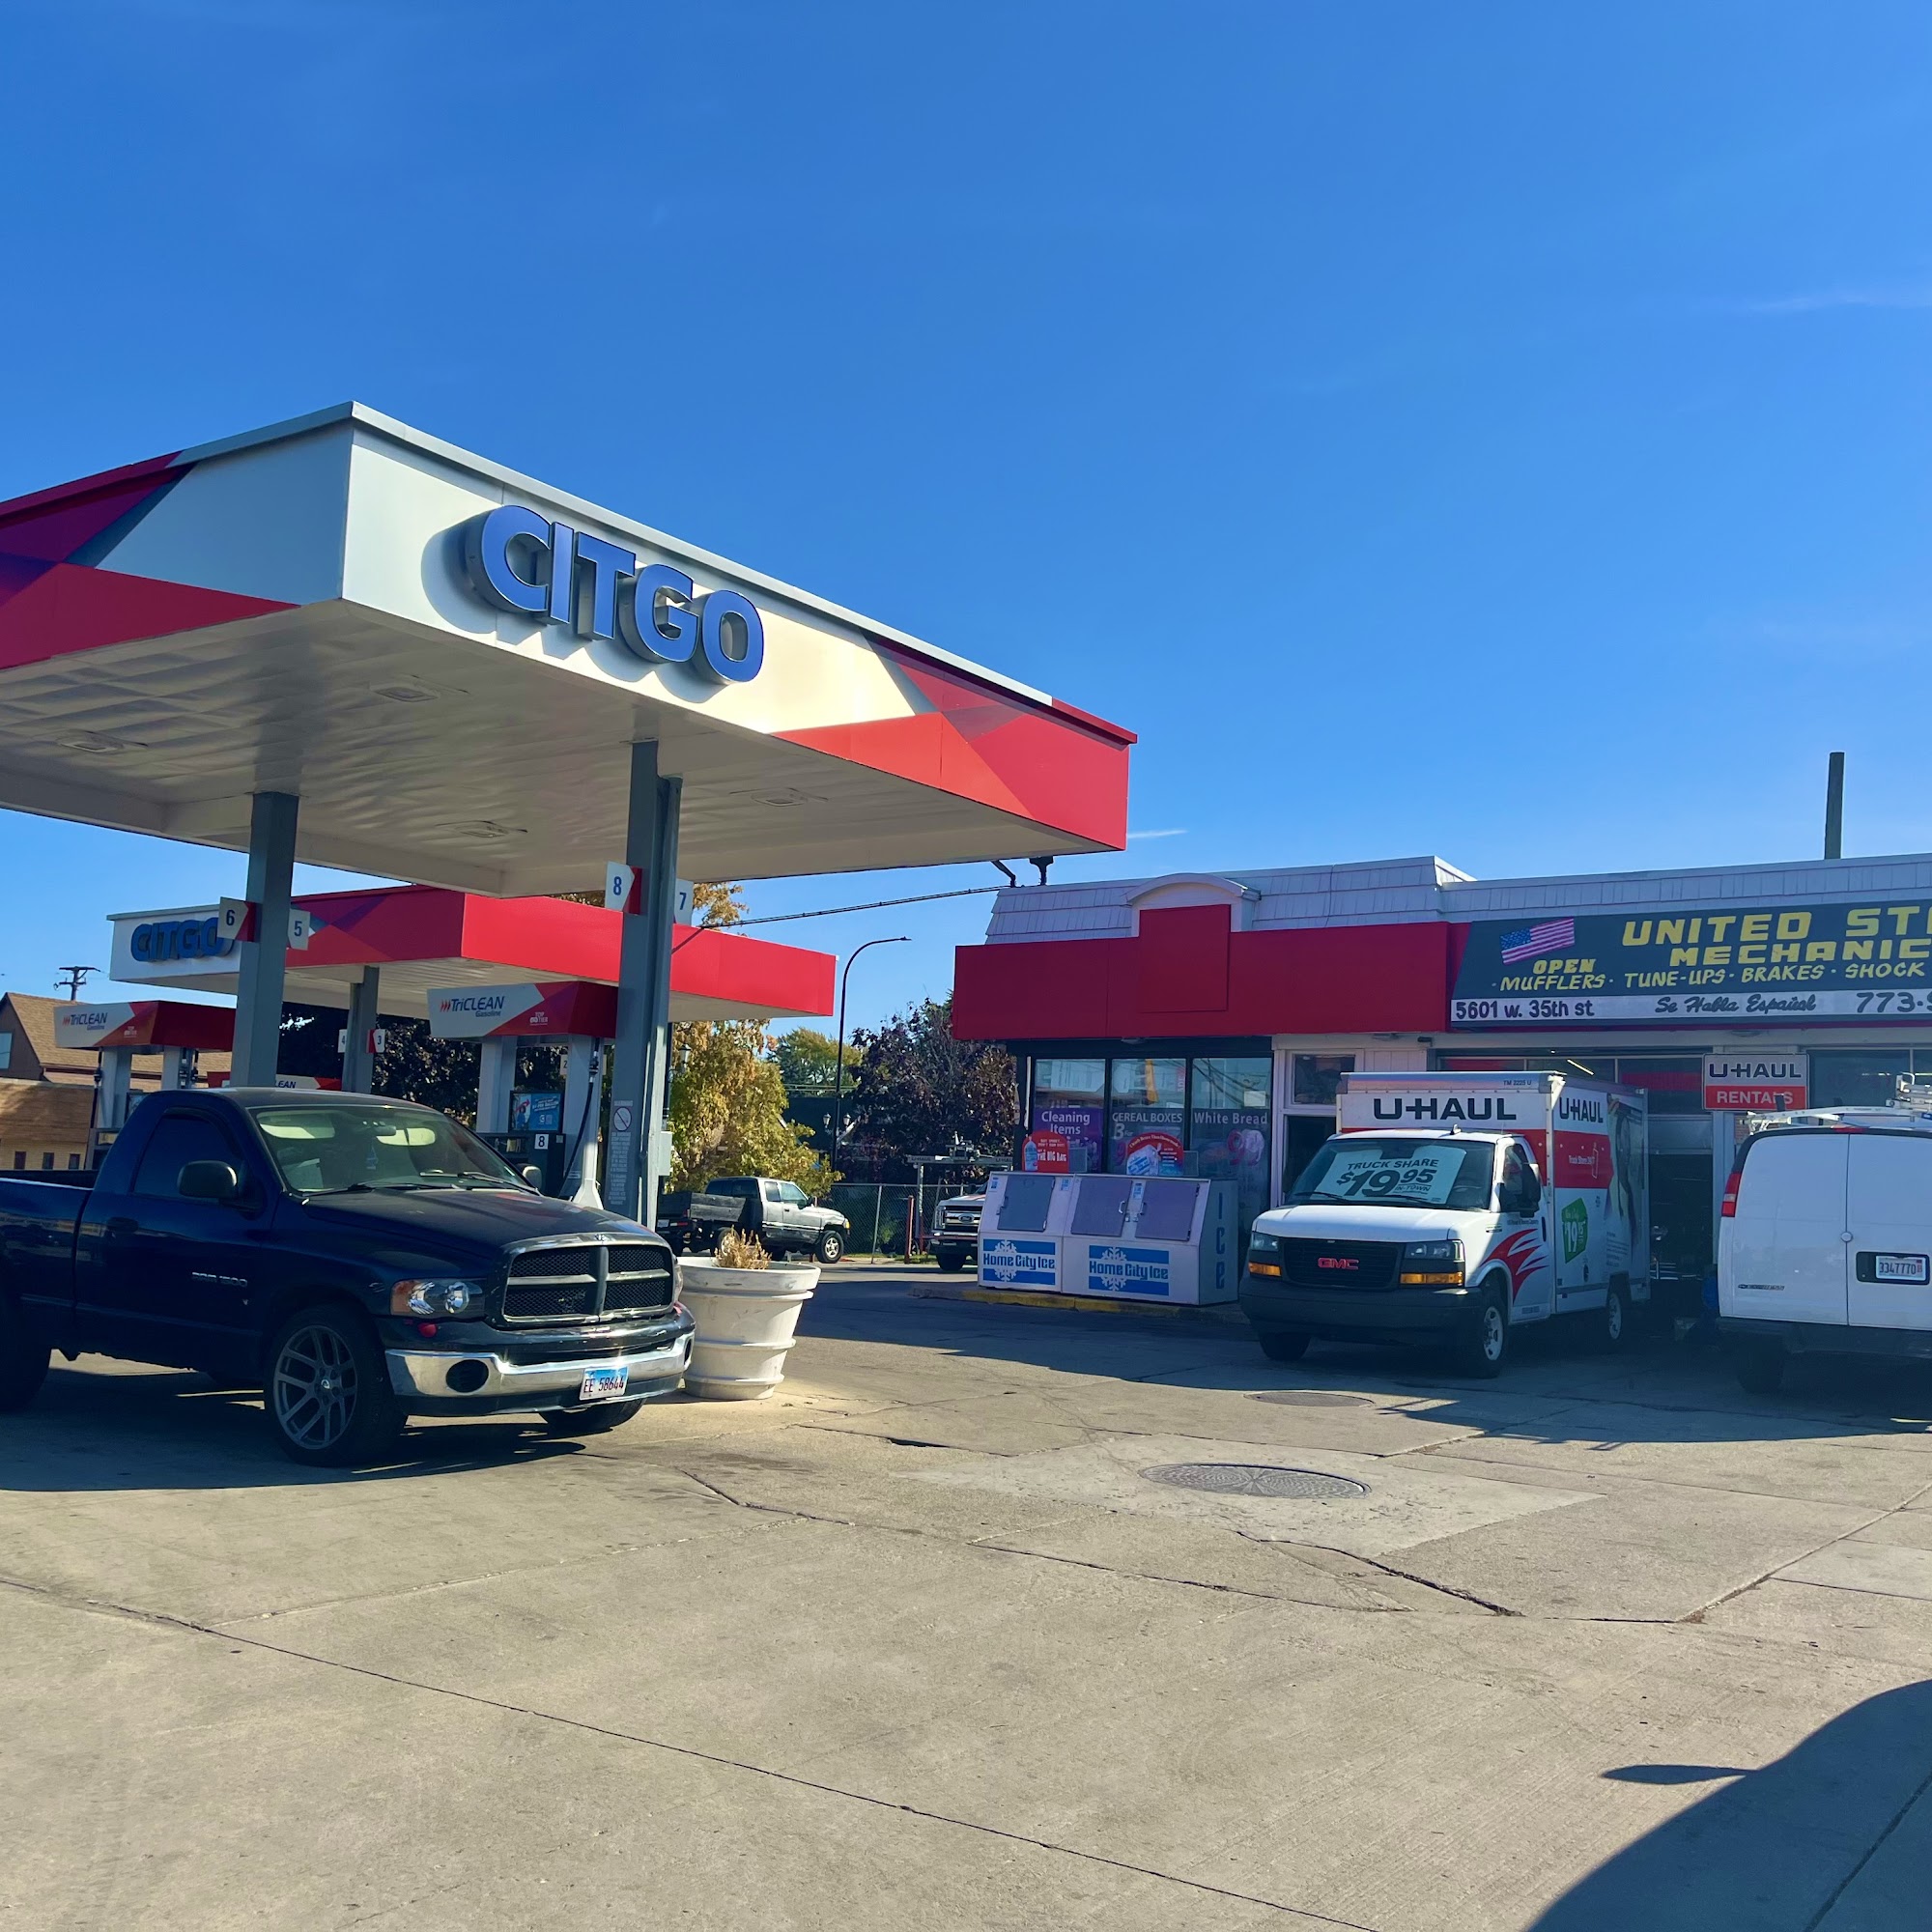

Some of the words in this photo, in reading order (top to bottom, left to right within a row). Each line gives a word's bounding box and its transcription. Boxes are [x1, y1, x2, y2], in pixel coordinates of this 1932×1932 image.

[470, 504, 764, 683] CITGO
[612, 876, 622, 895] 8
[679, 892, 687, 910] 7
[225, 909, 236, 926] 6
[1622, 912, 1812, 946] UNITED
[1845, 905, 1932, 937] ST
[294, 921, 302, 937] 5
[130, 917, 225, 962] CITGO
[1669, 938, 1932, 967] MECHANIC
[1532, 958, 1597, 975] OPEN
[1499, 974, 1606, 992] MUFFLERS
[1625, 968, 1725, 988] TUNE-UPS
[1741, 965, 1826, 983] BRAKES
[1845, 962, 1925, 979] SHOCK
[450, 996, 505, 1012] TriCLEAN
[1455, 1000, 1498, 1020] 5601
[1528, 1000, 1570, 1018] 35th
[1655, 996, 1678, 1013] Se
[1684, 996, 1740, 1013] Habla
[70, 1012, 108, 1026] TriCLEAN
[377, 1036, 383, 1045] 3
[1709, 1063, 1803, 1078] U-HAUL
[1717, 1091, 1794, 1104] RENTAS
[1112, 1112, 1151, 1122] CEREAL
[1151, 1112, 1183, 1123] BOXES
[1194, 1111, 1229, 1124] White
[1232, 1112, 1267, 1124] Bread
[1374, 1097, 1517, 1121] U-HAUL
[1559, 1096, 1604, 1123] U-HAUL
[1041, 1111, 1091, 1125] Cleaning
[1050, 1123, 1081, 1135] Items
[538, 1135, 546, 1148] 8
[1348, 1161, 1389, 1170] TRUCK
[1393, 1158, 1439, 1169] SHARE
[983, 1253, 1013, 1267] Home
[1015, 1255, 1037, 1270] City
[1037, 1257, 1055, 1268] Ice
[1318, 1257, 1359, 1270] GMC
[1090, 1261, 1123, 1276] Home
[1124, 1262, 1148, 1280] City
[1149, 1265, 1169, 1280] Ice
[583, 1378, 595, 1393] EE
[598, 1376, 624, 1392] 58644
